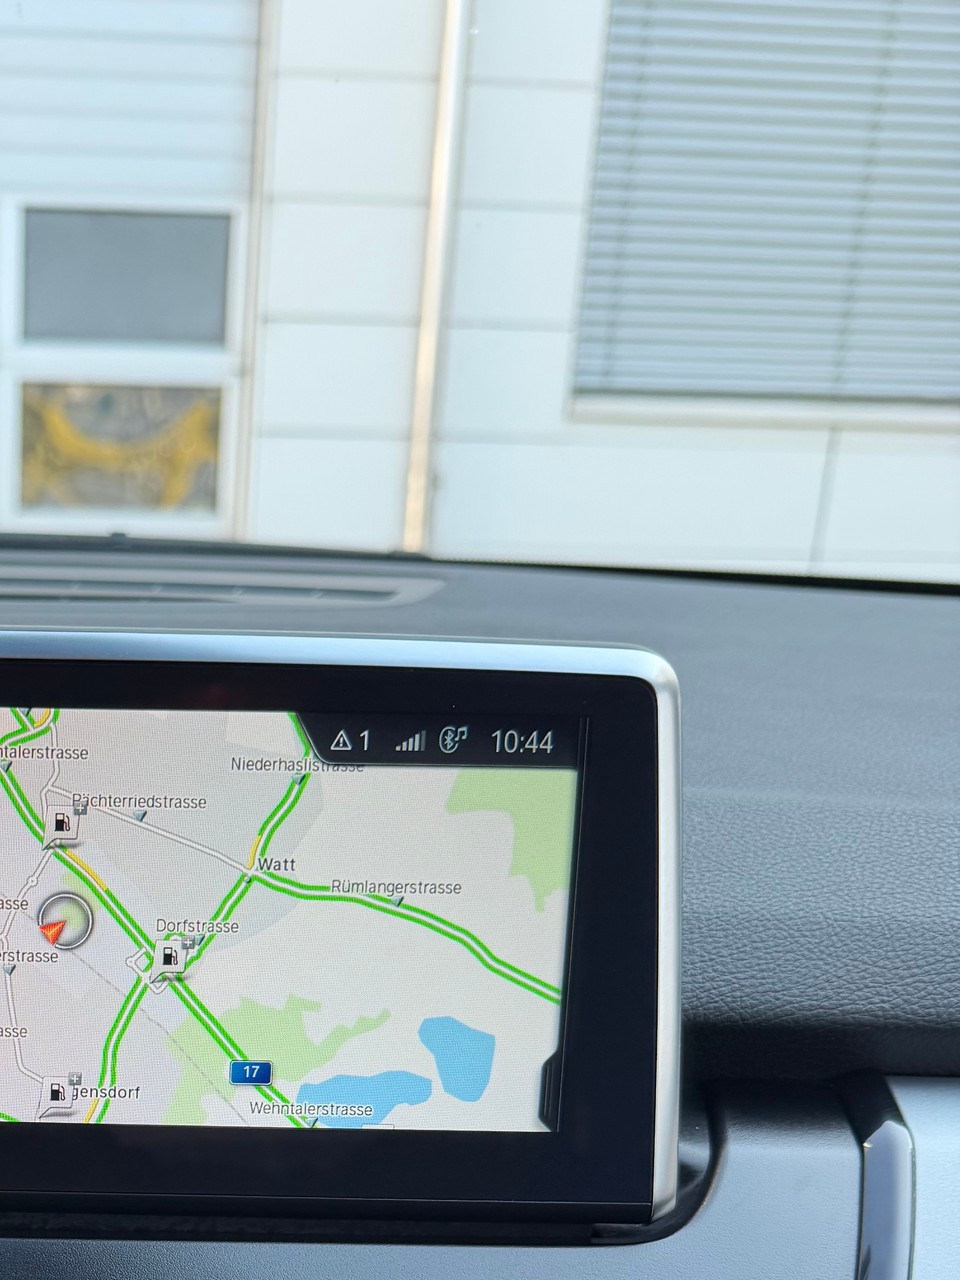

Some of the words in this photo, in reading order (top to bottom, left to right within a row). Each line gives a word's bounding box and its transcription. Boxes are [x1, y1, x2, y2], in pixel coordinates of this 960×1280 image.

[359, 730, 369, 751] 1
[491, 730, 554, 754] 10:44
[258, 858, 295, 872] Watt
[331, 880, 462, 897] Rümlangerstrasse
[156, 918, 239, 934] Dorfstrasse
[243, 1066, 260, 1079] 17
[72, 1086, 141, 1101] gensdorf
[249, 1101, 373, 1117] Wehntalerstrasse
